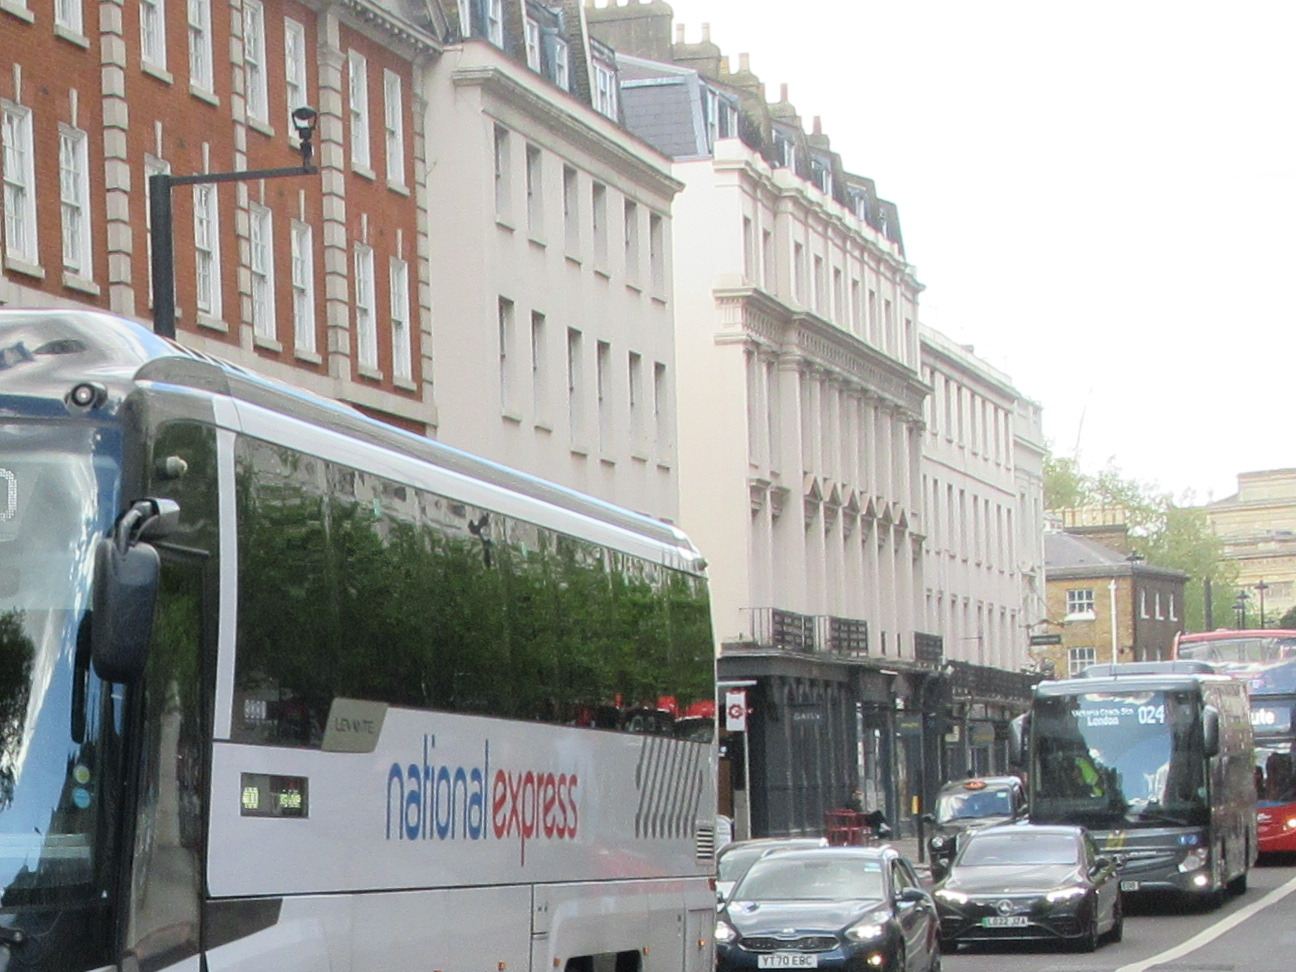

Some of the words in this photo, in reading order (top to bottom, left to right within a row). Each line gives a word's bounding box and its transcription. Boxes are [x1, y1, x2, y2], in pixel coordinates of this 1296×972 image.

[1087, 715, 1120, 727] London
[1137, 704, 1165, 725] 024
[386, 733, 489, 841] national
[492, 768, 579, 868] express
